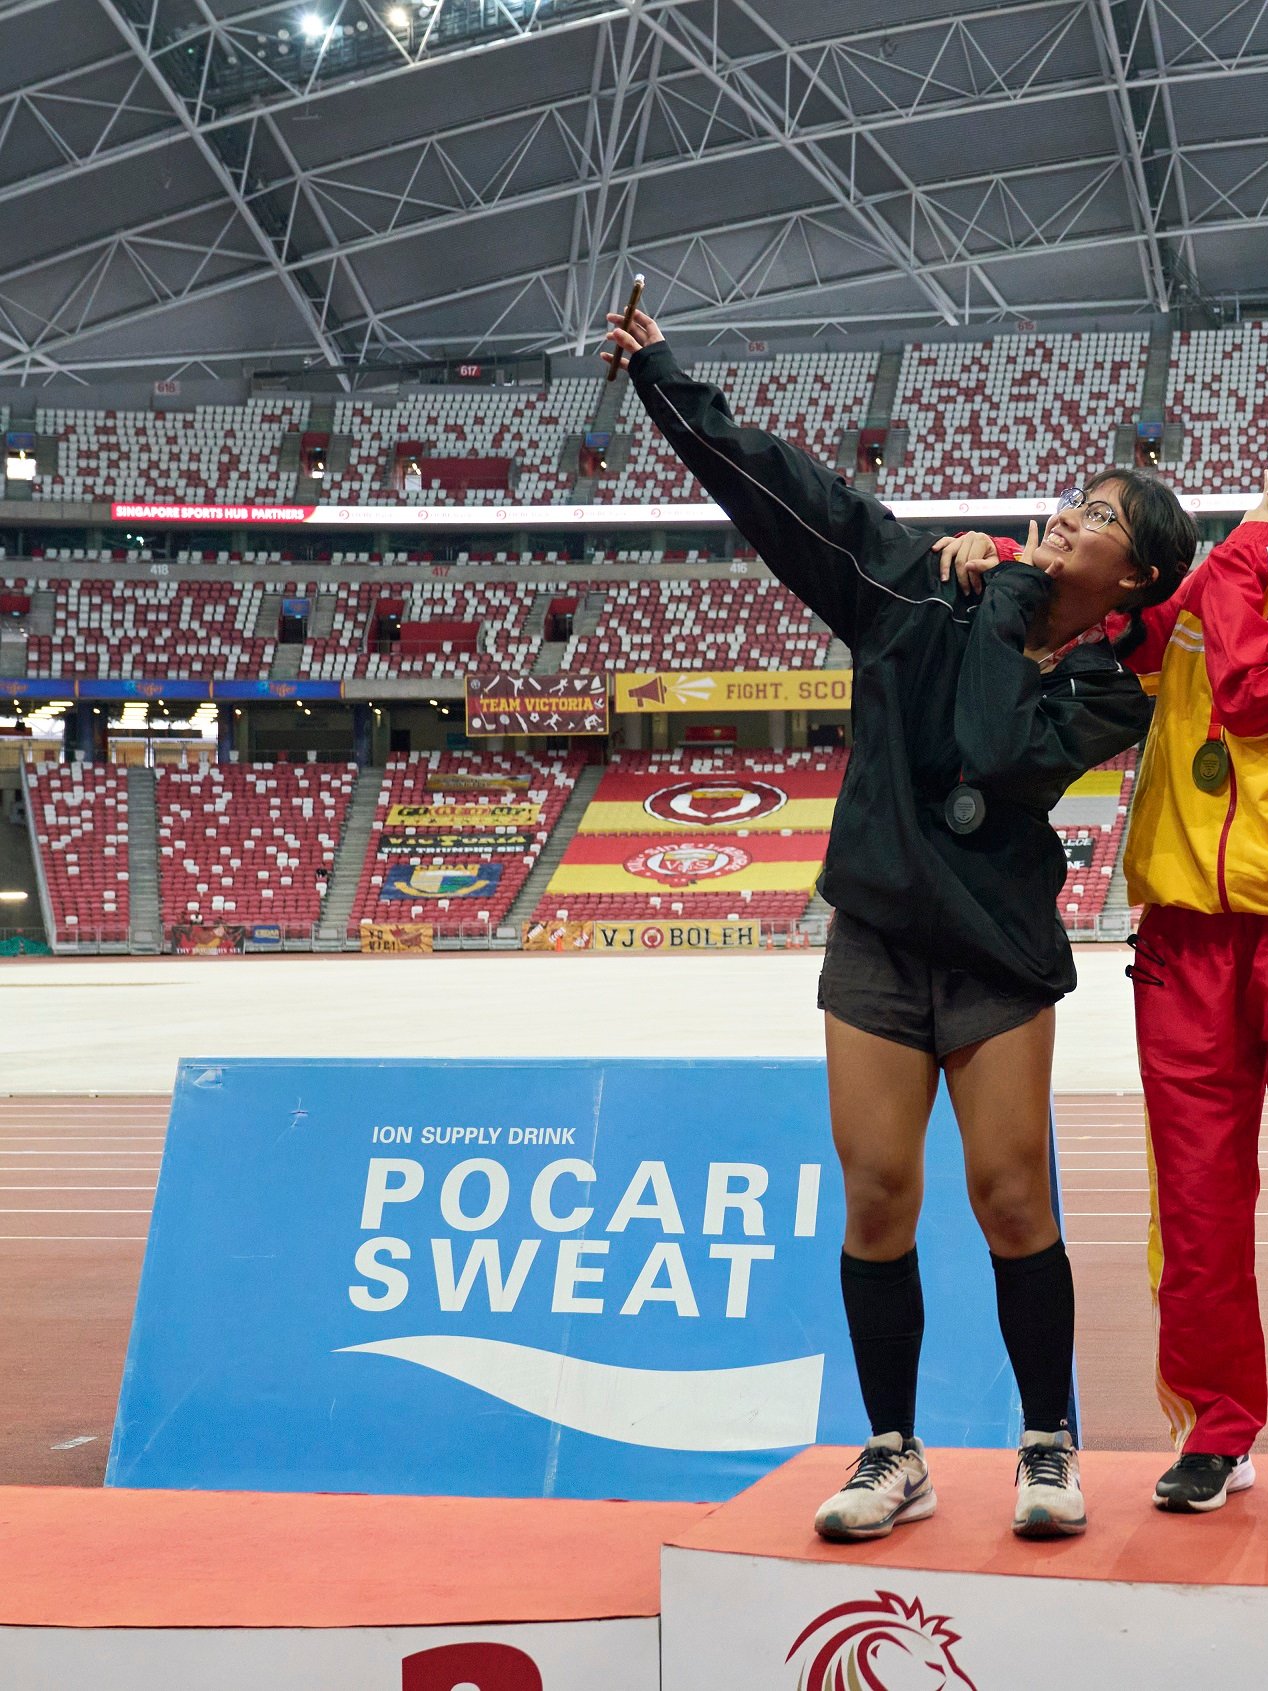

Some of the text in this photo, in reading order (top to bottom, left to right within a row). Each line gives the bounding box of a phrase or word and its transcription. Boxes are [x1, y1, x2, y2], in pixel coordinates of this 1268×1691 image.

[460, 366, 477, 376] 617
[116, 505, 304, 521] SINGAPORE SPORTS HUB PARTNERS
[150, 564, 169, 576] 418
[432, 566, 449, 577] 417
[730, 562, 748, 574] 416
[479, 697, 594, 713] TEAM VICTORIA
[601, 928, 634, 948] VJ
[670, 927, 753, 947] BOLEH
[371, 1126, 577, 1145] ION SUPPLY DRINK
[360, 1157, 822, 1238] POCARI
[348, 1236, 776, 1319] SWEAT
